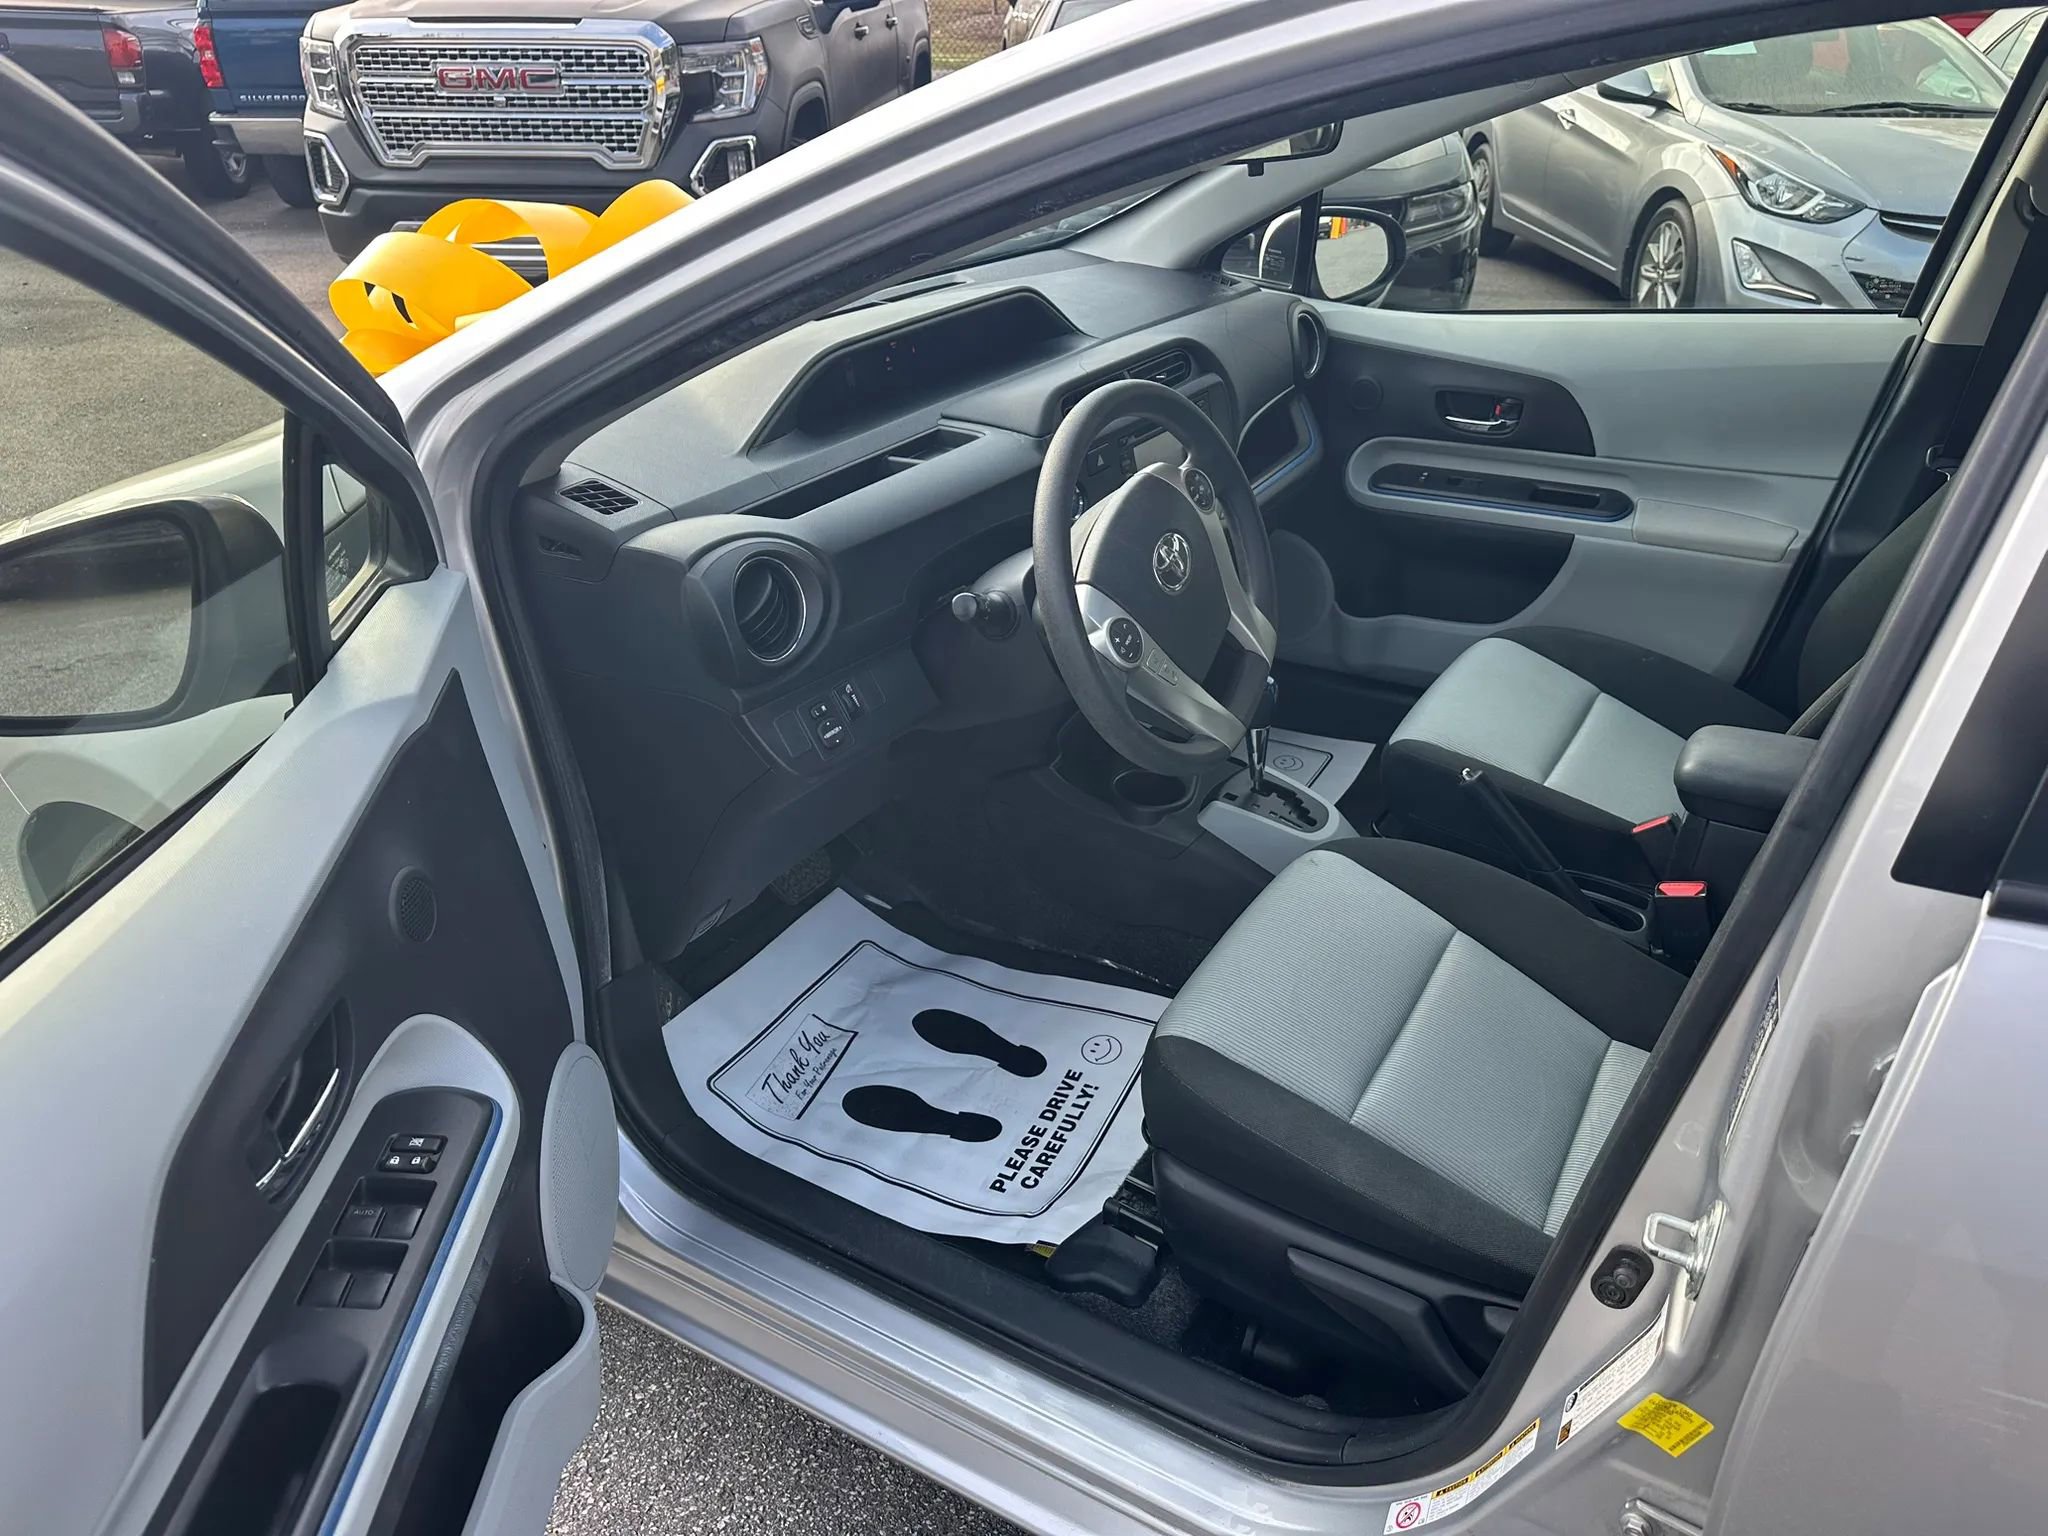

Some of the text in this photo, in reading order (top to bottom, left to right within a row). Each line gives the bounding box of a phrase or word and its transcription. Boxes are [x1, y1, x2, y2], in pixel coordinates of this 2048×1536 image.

[437, 66, 559, 91] GMC
[761, 1030, 831, 1104] Thank You
[795, 1088, 807, 1100] For
[803, 1075, 817, 1088] Your
[989, 1124, 1048, 1193] PLEASE
[1038, 1069, 1083, 1122] DRIVE
[1020, 1083, 1100, 1189] CAREFULLY!
